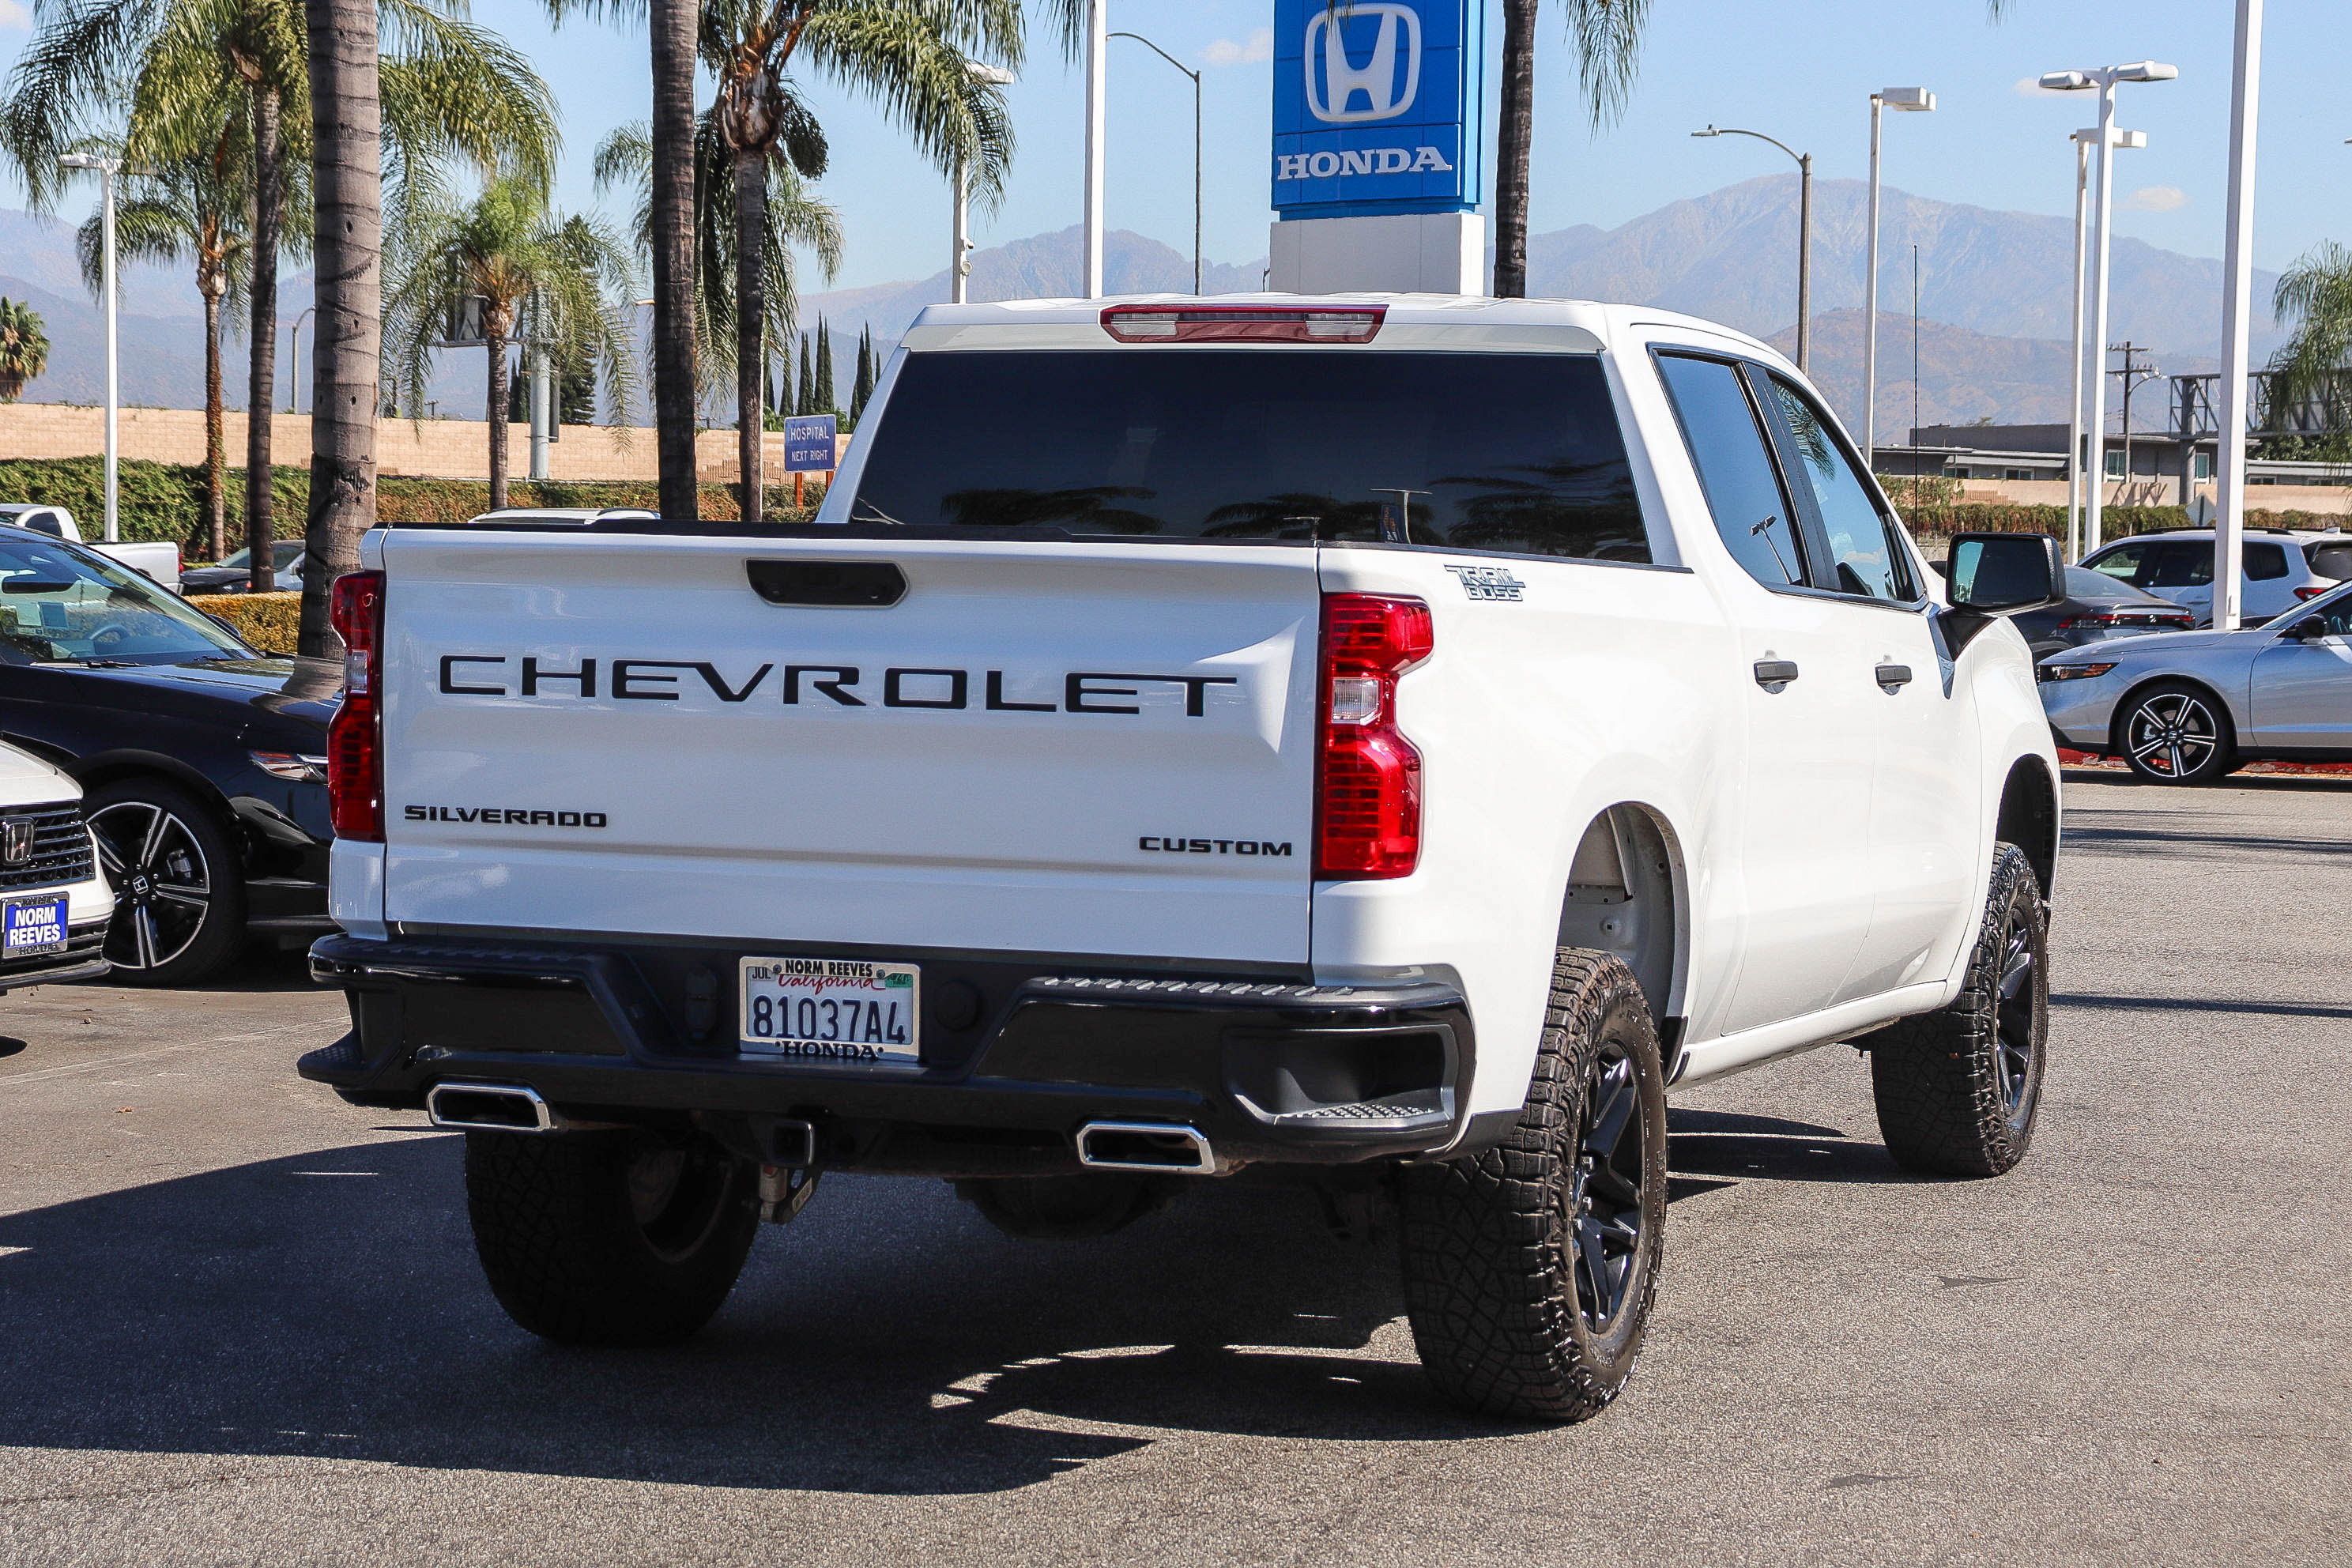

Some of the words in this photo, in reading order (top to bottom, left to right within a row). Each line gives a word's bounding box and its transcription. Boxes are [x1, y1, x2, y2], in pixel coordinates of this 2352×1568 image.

[1277, 146, 1452, 180] HONDA
[790, 426, 829, 441] HOSPITAL
[791, 450, 808, 462] NEXT
[810, 449, 827, 461] RIGHT
[1444, 565, 1525, 588] TRAIL
[1464, 585, 1523, 601] BOSS
[440, 654, 1238, 717] CHEVROLET
[405, 805, 607, 827] SILVERADO
[1139, 836, 1292, 856] CUSTOM
[16, 906, 56, 927] NORM
[9, 923, 60, 946] REEVES
[752, 967, 771, 979] JUL
[785, 959, 824, 974] NORM
[829, 963, 873, 977] REEVES
[778, 974, 886, 995] California
[752, 995, 906, 1044] 81037A4
[782, 1040, 879, 1061] HONDA
